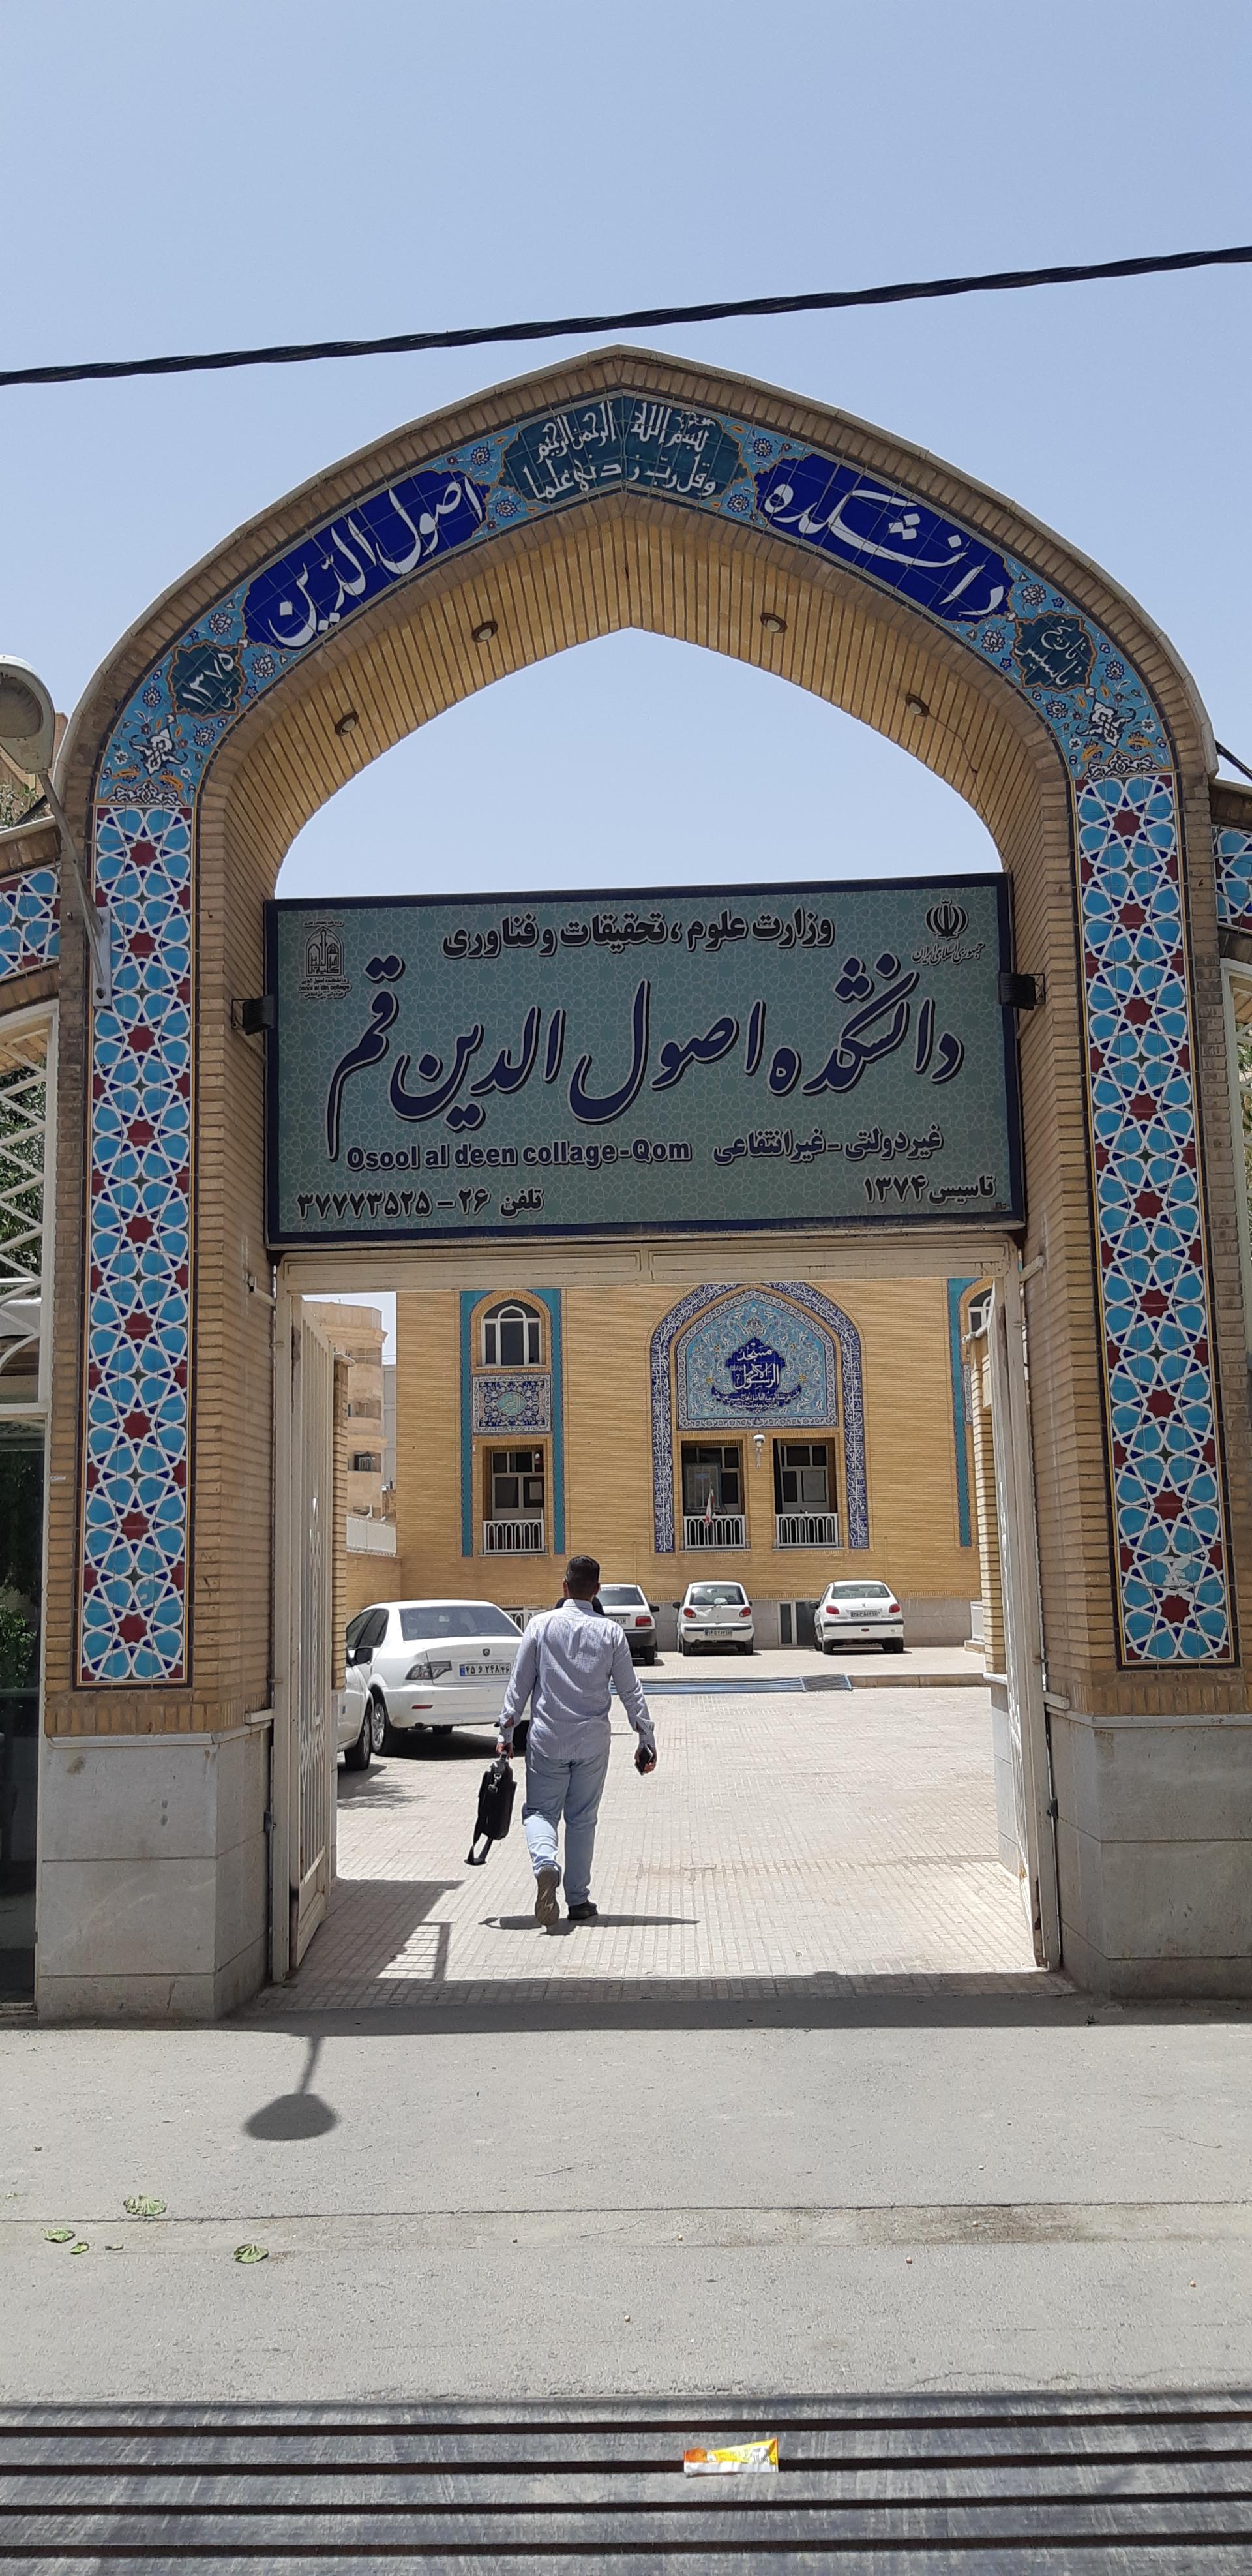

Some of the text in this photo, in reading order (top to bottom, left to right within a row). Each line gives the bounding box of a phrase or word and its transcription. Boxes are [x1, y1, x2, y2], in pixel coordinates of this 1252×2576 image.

[571, 400, 616, 450] الرحمن
[631, 402, 672, 443] الله
[375, 476, 483, 575] اصول
[764, 484, 1005, 616] دانشکده
[182, 653, 234, 706] ۱۳۷۵
[559, 912, 666, 954] تحقیقات
[687, 909, 748, 952] علوم
[751, 907, 833, 948] وزارت
[326, 952, 965, 1160] دانشکده اصول الدین قم
[346, 1145, 419, 1170] Osool
[425, 1144, 449, 1168] al
[455, 1143, 518, 1167] deen
[297, 1189, 432, 1219] ۳۷۷۷۳۵۲۵
[457, 1187, 490, 1215] ۲۶
[500, 1188, 544, 1219] تلفن
[863, 1175, 996, 1206] تاسیس ۱۳۷۴
[737, 1343, 772, 1361] مسجد
[466, 1665, 476, 1674] ۴۵
[484, 1665, 499, 1674] ۲۴۸
